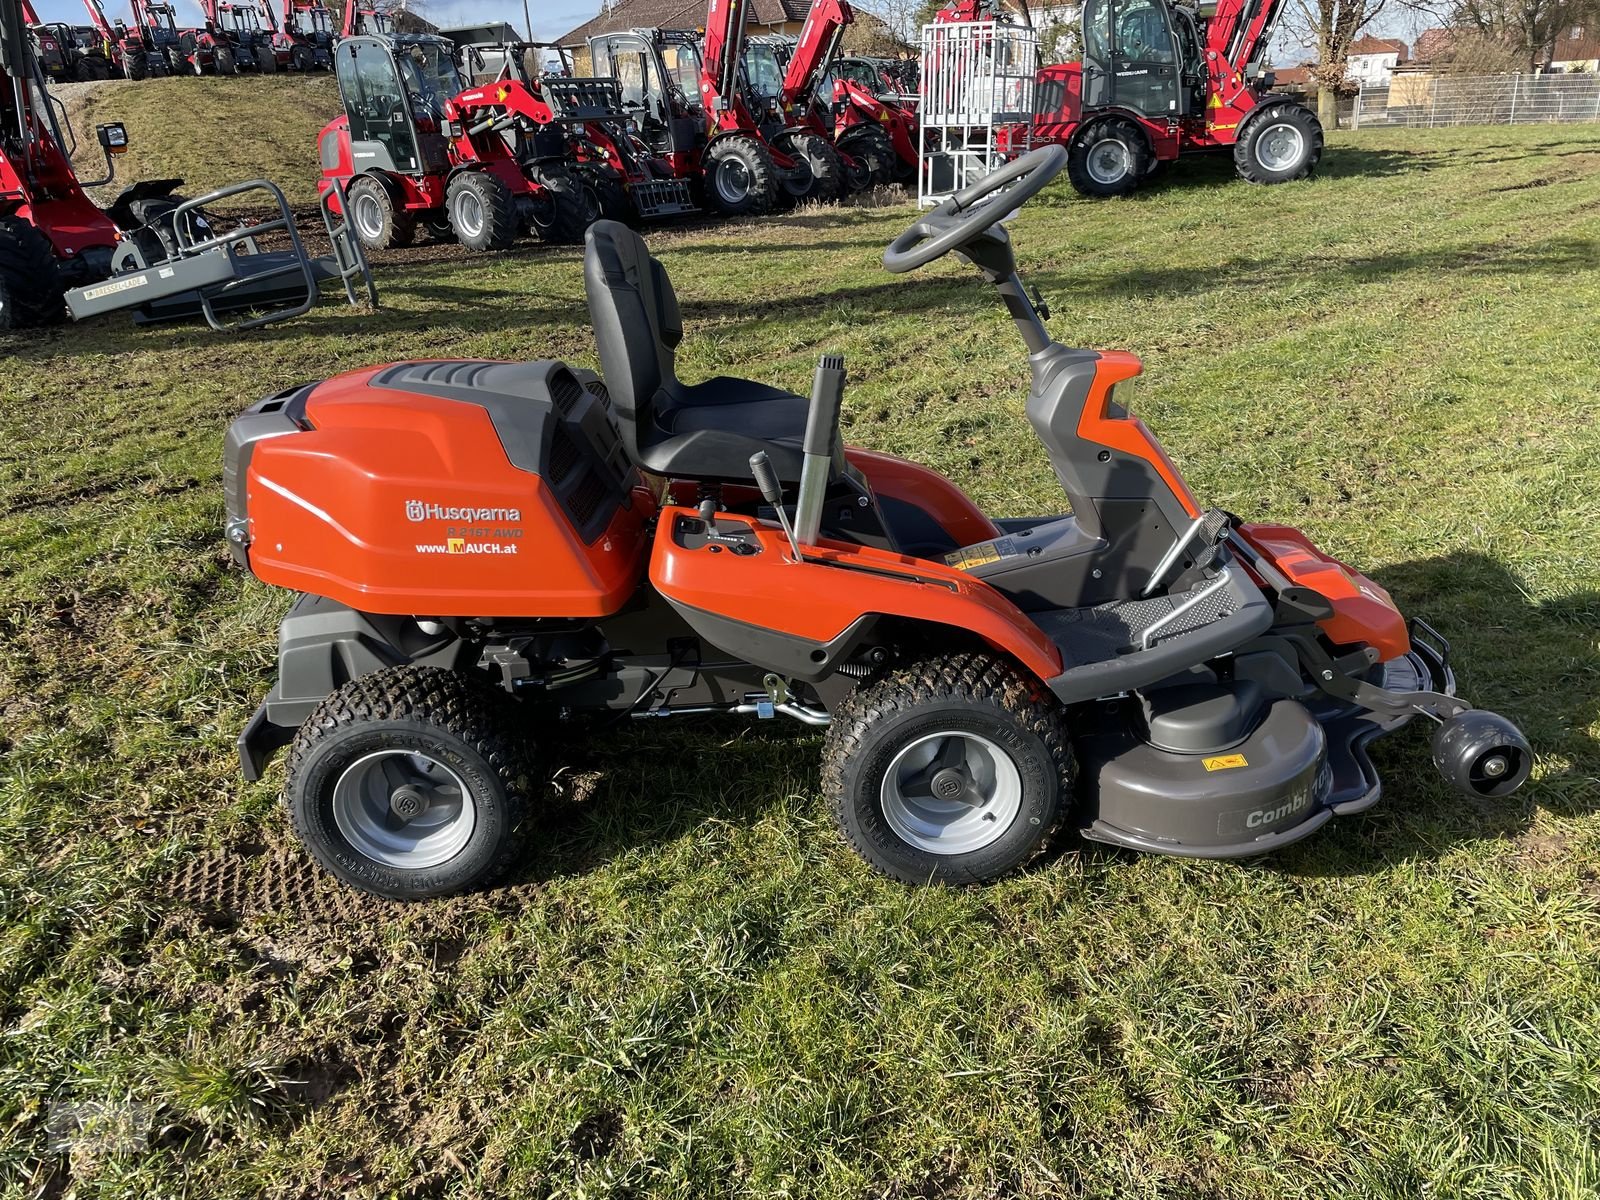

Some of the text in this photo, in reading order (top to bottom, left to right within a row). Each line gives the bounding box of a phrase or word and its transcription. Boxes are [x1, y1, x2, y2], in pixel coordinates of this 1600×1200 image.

[425, 503, 522, 524] Husqvarna
[447, 527, 524, 539] R 216T AWD
[1246, 788, 1308, 829] Combi
